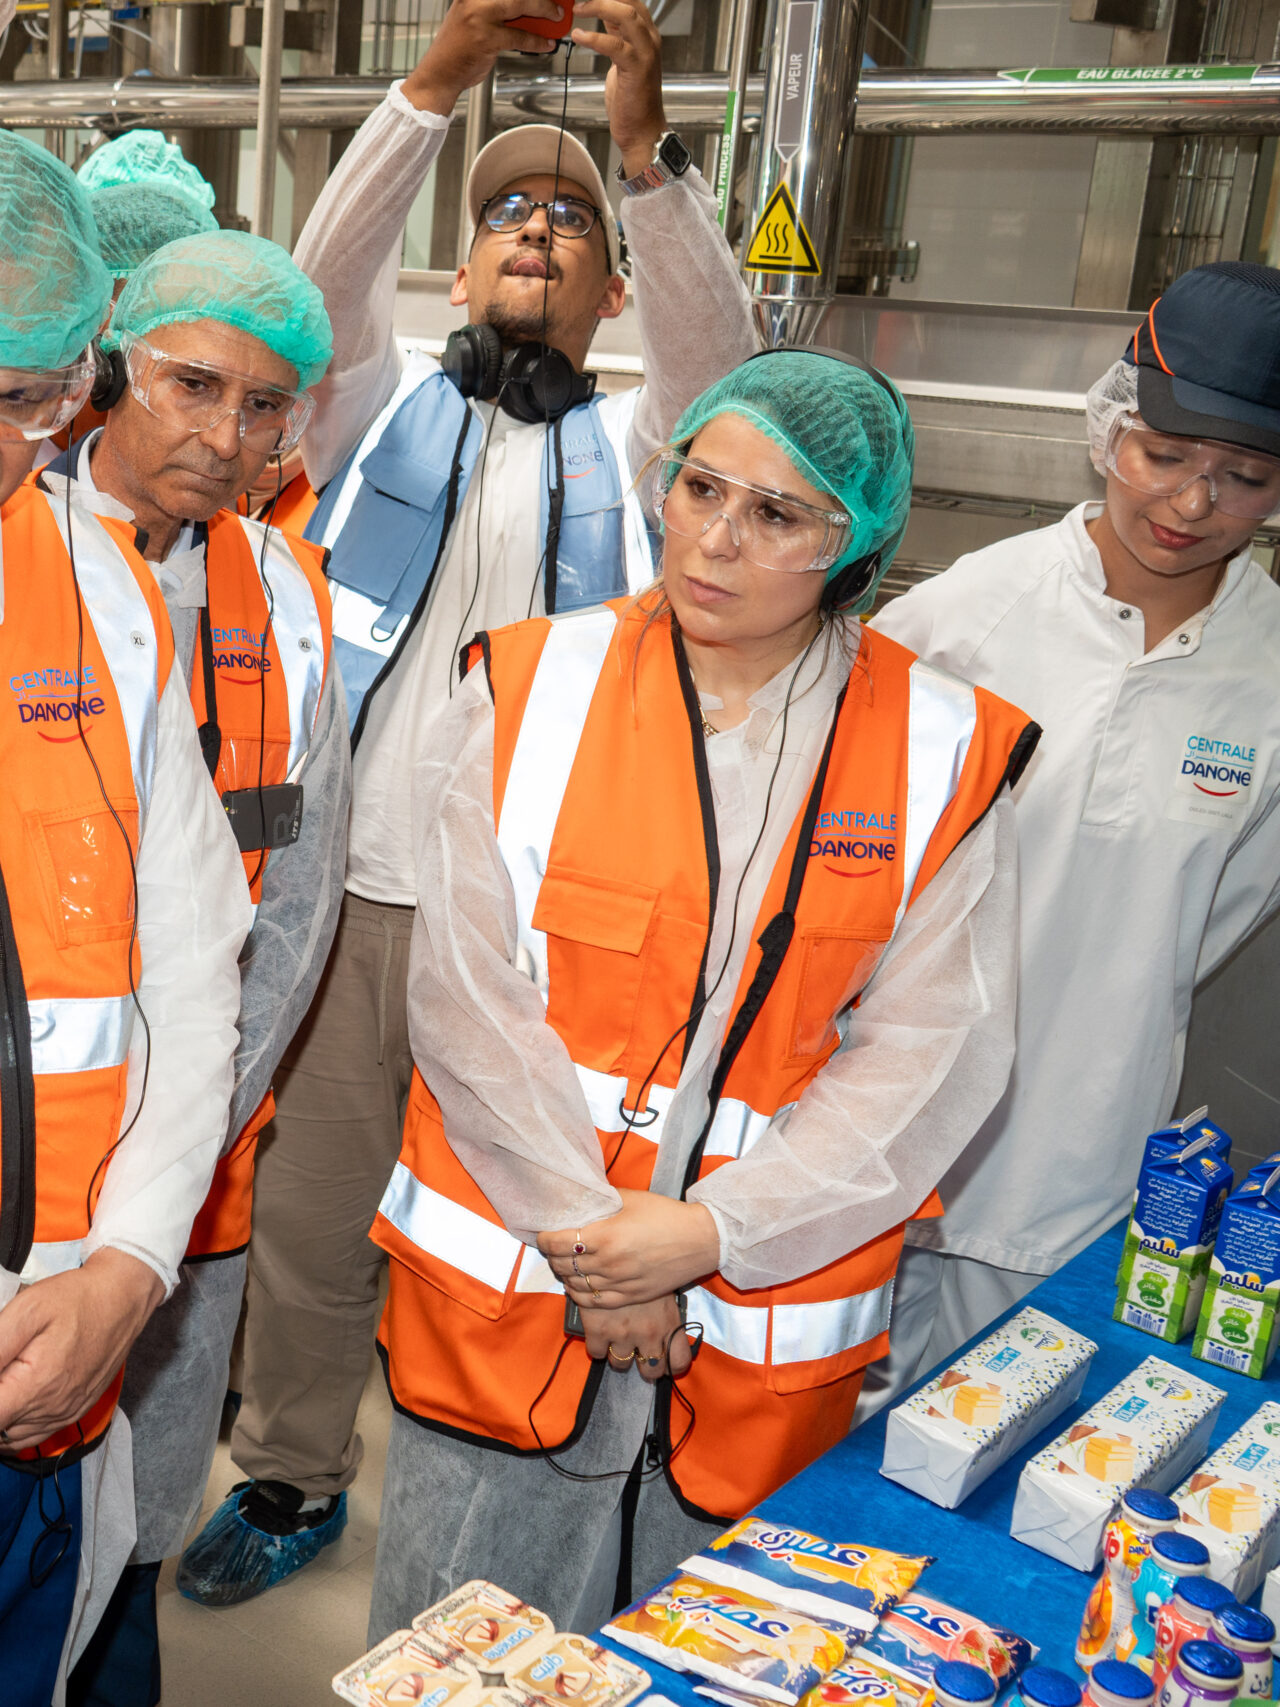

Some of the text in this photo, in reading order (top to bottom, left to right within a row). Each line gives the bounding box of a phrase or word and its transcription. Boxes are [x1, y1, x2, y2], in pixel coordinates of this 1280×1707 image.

[786, 53, 803, 100] VAPEUR
[1077, 69, 1109, 79] EAU
[719, 133, 731, 186] PROCESS
[133, 636, 145, 646] XL
[210, 628, 268, 647] ENTRALE
[300, 641, 310, 649] XL
[9, 665, 97, 692] CENTRALE
[1187, 735, 1256, 762] CENTRALE
[814, 811, 897, 831] ENTRALE
[1138, 1238, 1180, 1260] سليم
[1219, 1273, 1265, 1294] سليم
